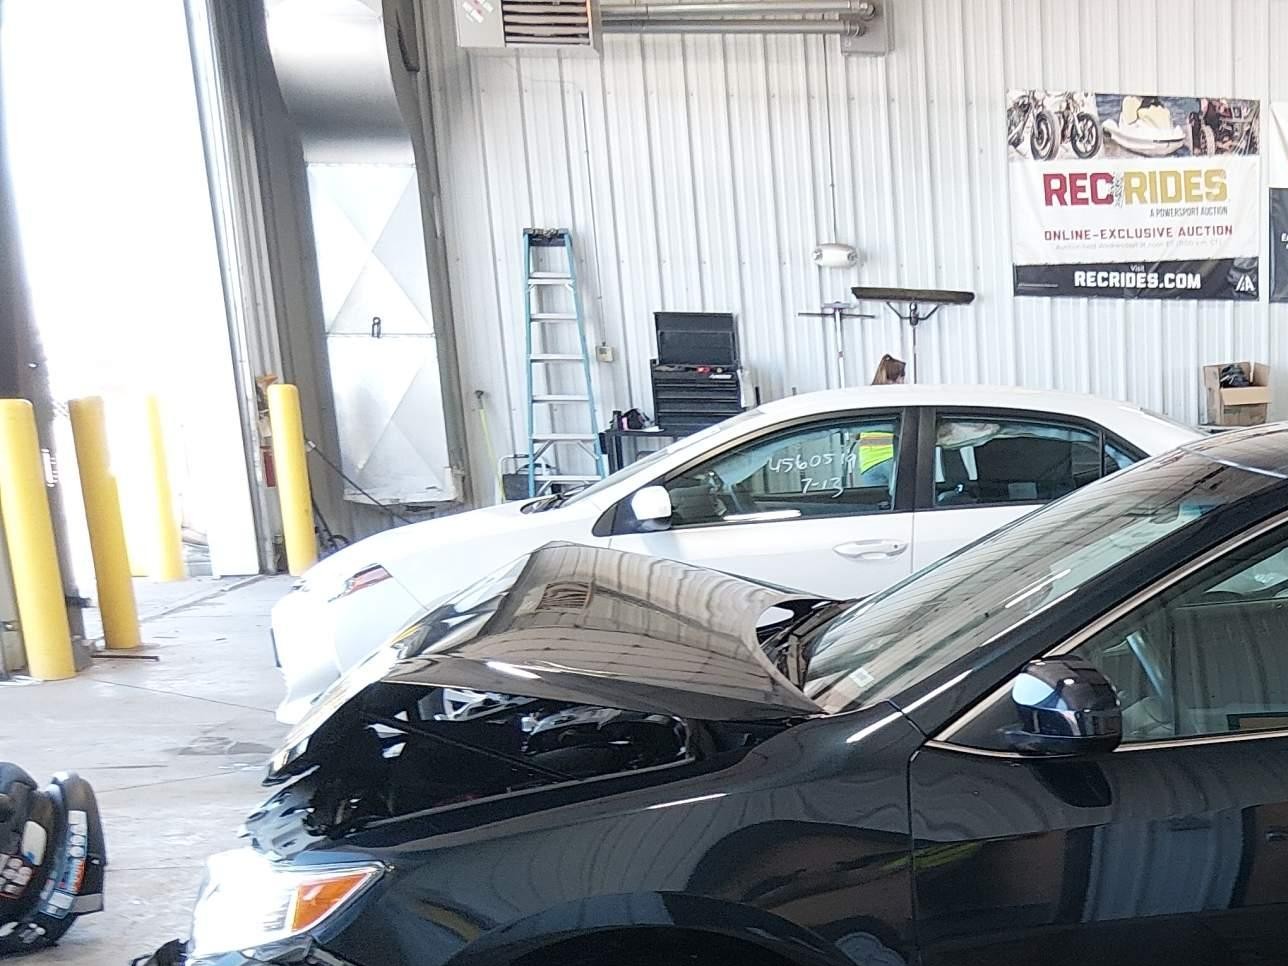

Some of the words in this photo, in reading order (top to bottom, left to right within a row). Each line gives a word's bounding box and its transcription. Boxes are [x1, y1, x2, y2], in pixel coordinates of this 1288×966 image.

[1043, 172, 1114, 206] REC
[1124, 169, 1228, 205] RIDES
[1200, 206, 1228, 216] AUCTION
[1044, 227, 1173, 241] ONLINE-EXCLUSIVE
[1178, 225, 1233, 237] AUCTION
[1074, 271, 1202, 290] RECRIDES.COM
[801, 477, 844, 499] 7-13
